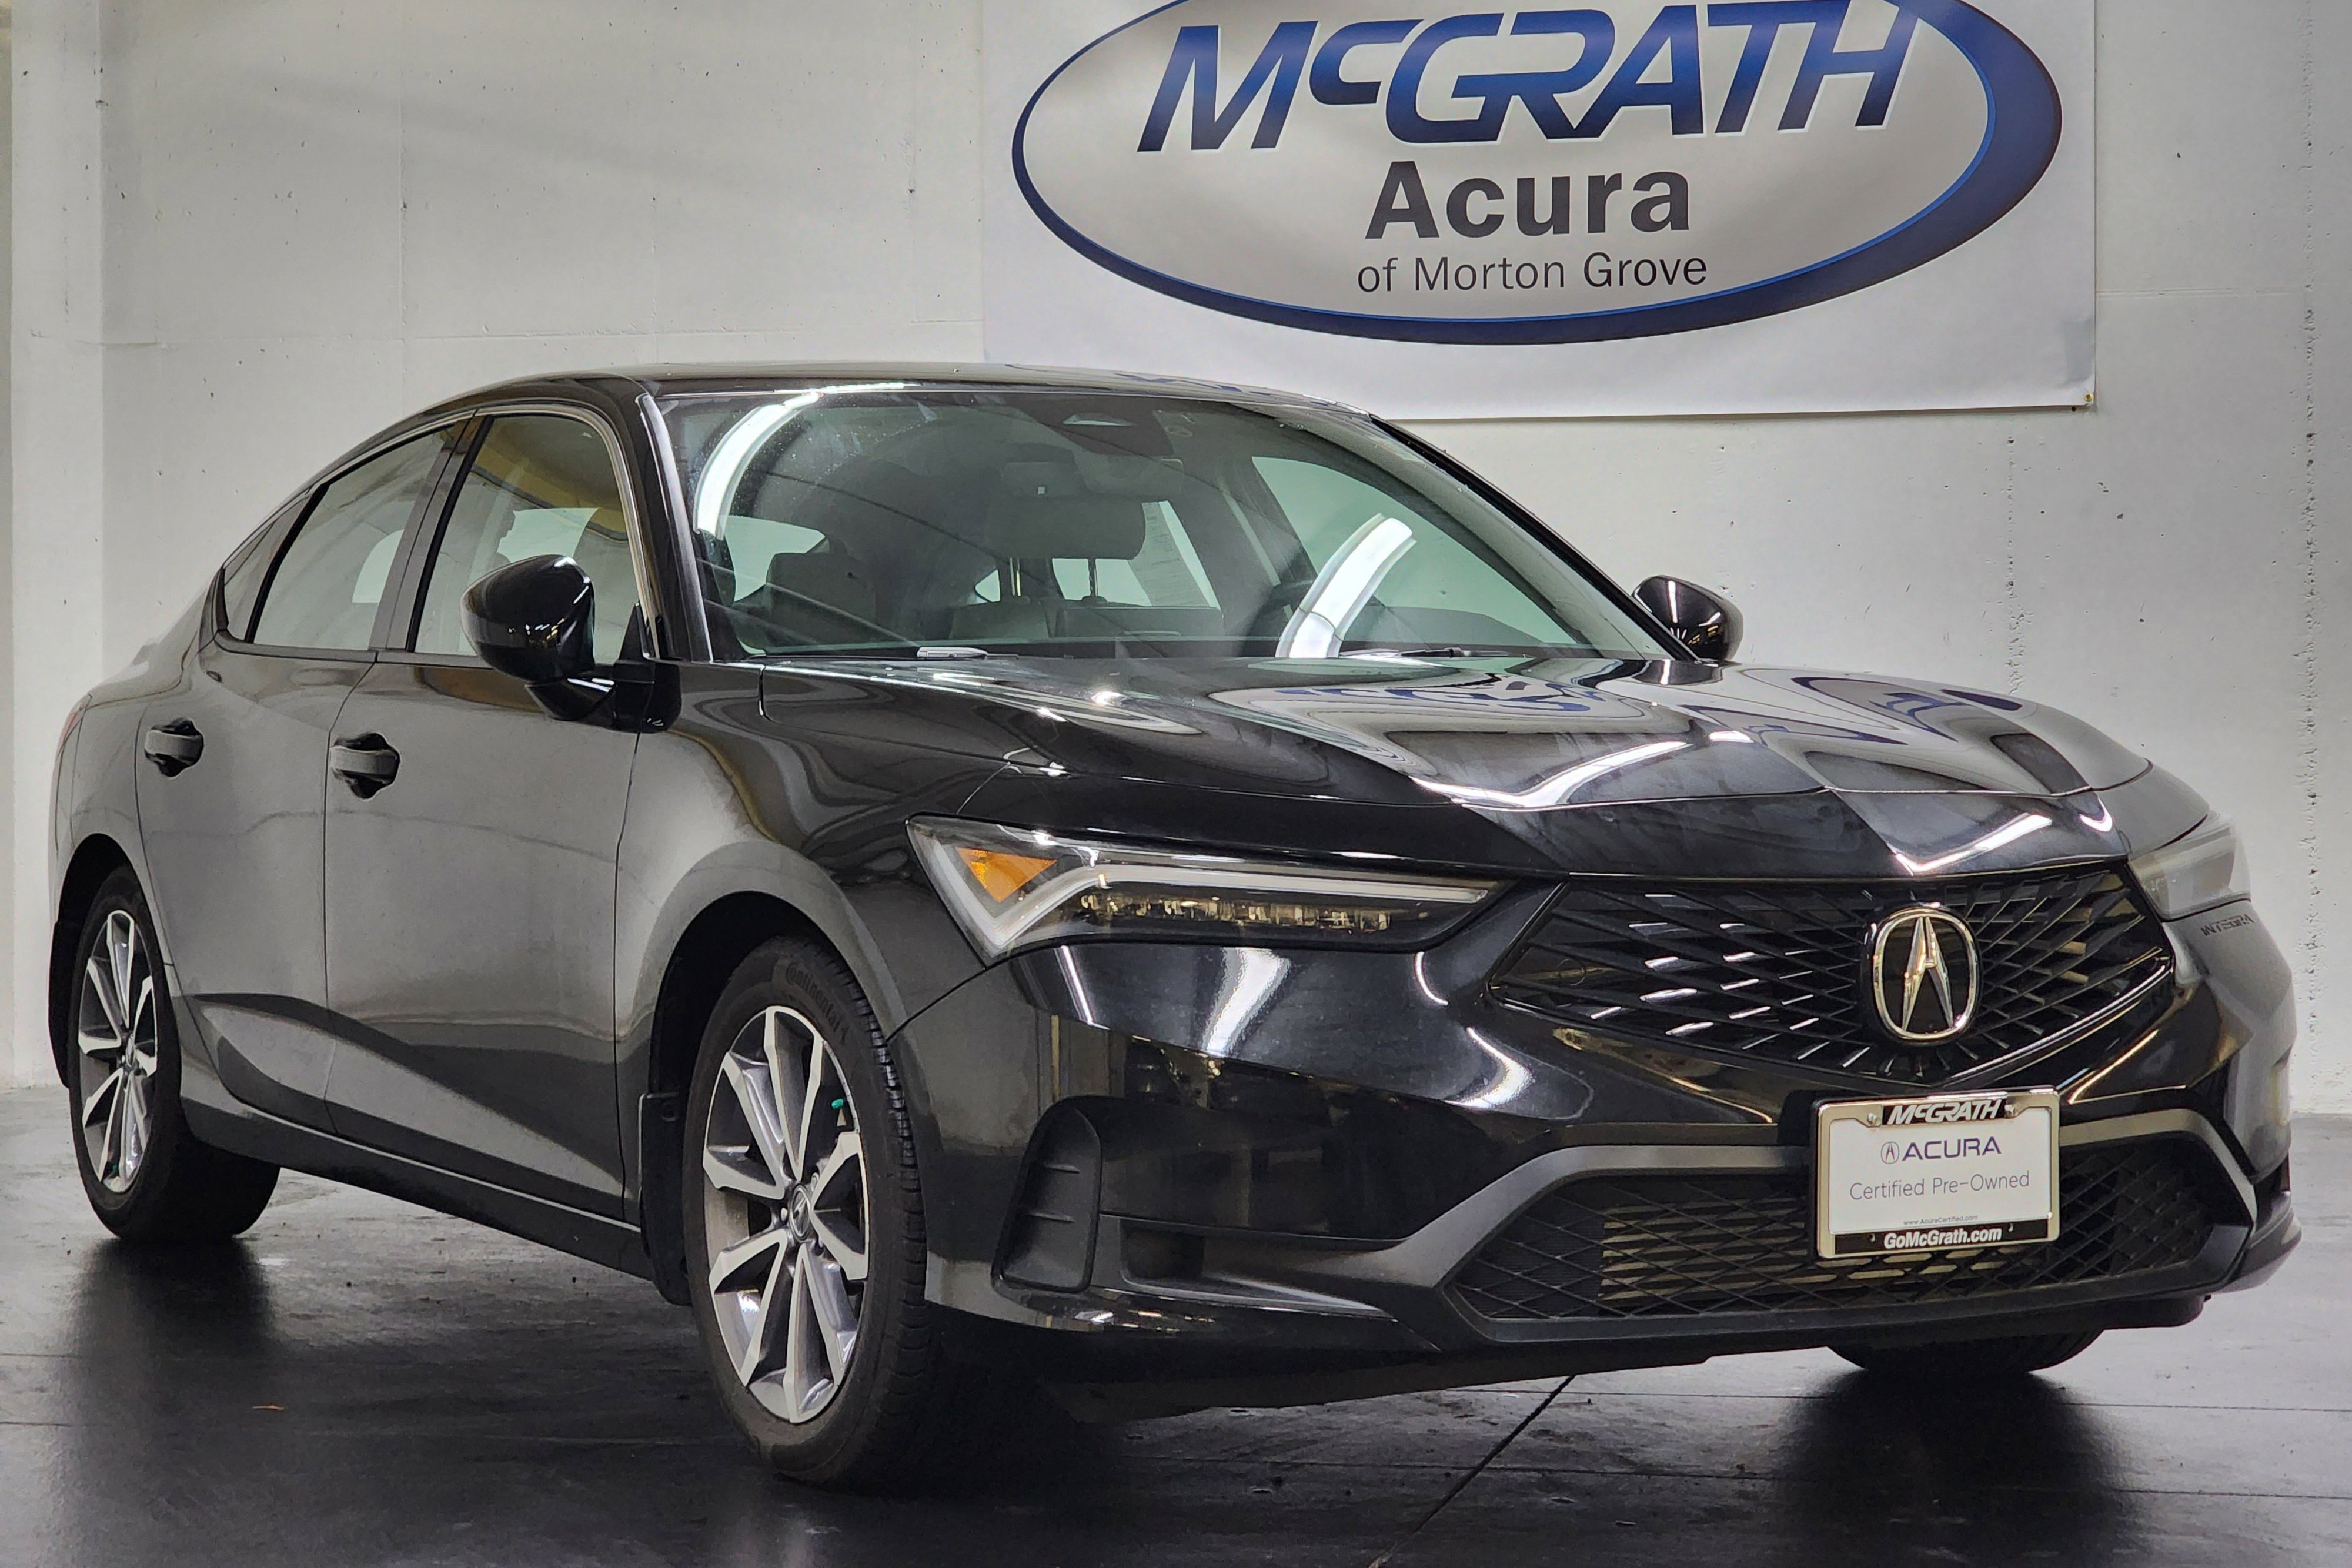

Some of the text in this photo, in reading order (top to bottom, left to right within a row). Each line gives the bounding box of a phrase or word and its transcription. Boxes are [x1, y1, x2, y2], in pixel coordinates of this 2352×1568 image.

[1365, 161, 1689, 239] Acura
[1357, 252, 1707, 293] of Morton Grove
[786, 962, 841, 1033] Continental
[1902, 1136, 2002, 1161] ACURA
[1849, 1170, 2030, 1200] Certified Pre-Owned
[1903, 1215, 1978, 1226] www.AcuraCertified.com
[1883, 1228, 2002, 1249] GoMcGrath.com
